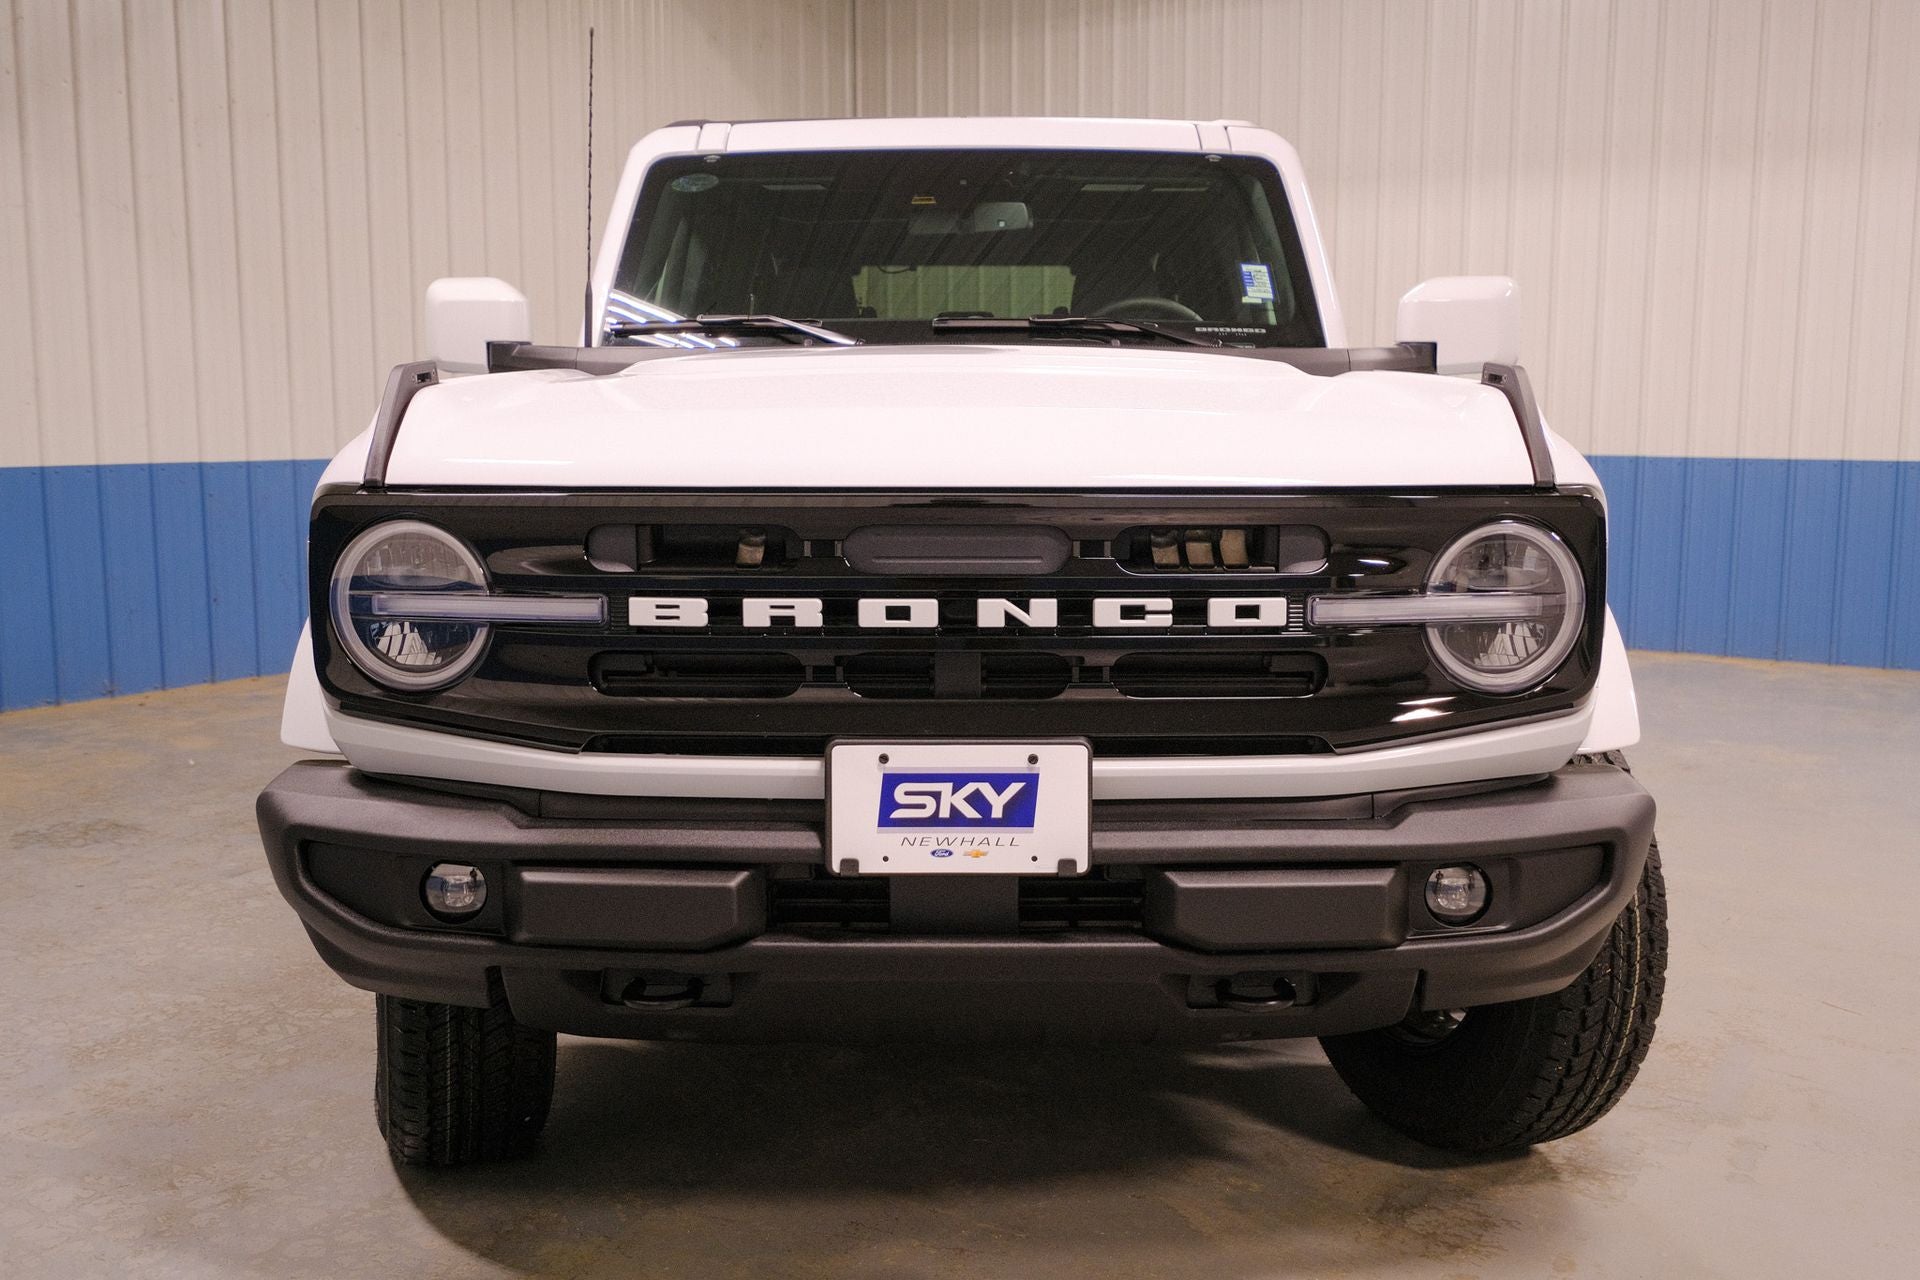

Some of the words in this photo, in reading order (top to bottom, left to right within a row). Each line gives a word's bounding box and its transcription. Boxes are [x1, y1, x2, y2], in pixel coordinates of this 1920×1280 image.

[629, 597, 1287, 628] BRONCO
[889, 782, 1026, 818] SKY
[901, 837, 1020, 846] NEWHALL
[932, 849, 952, 857] Ford
